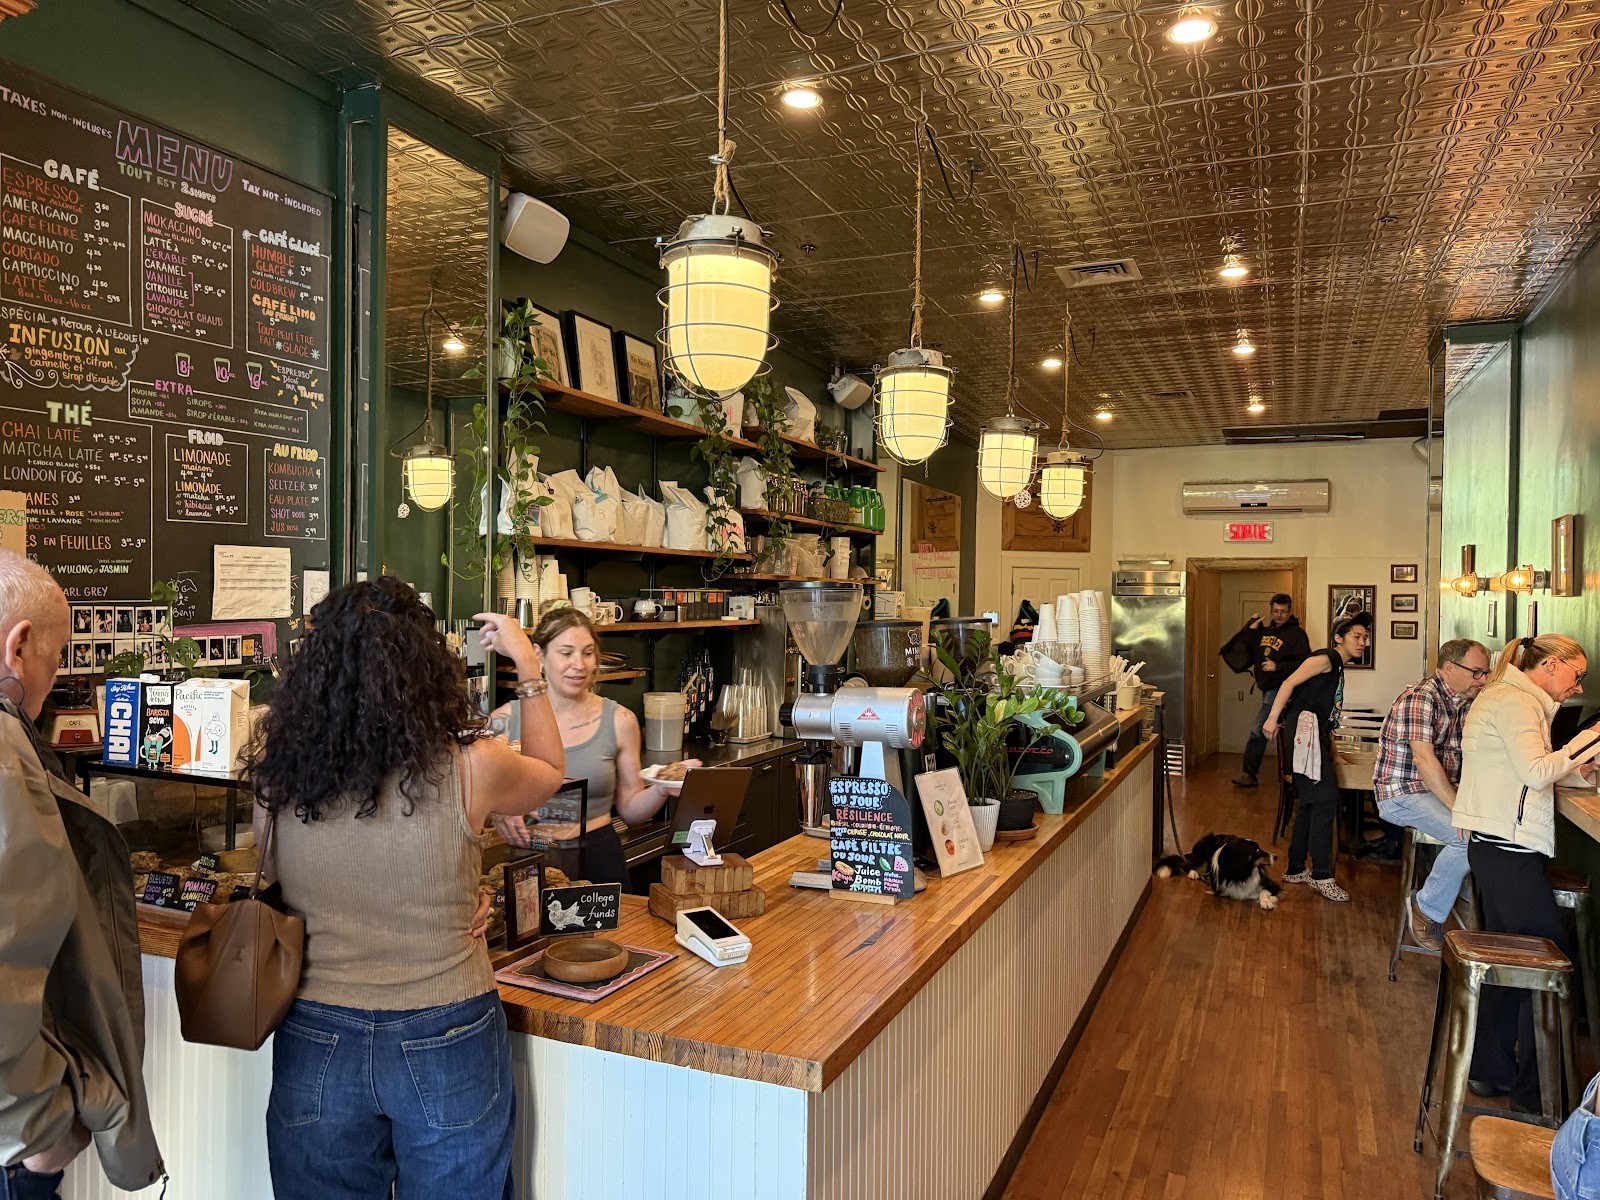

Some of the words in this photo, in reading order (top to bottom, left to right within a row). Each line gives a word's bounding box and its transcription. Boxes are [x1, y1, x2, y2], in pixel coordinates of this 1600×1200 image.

[0, 85, 47, 117] TAXES
[115, 120, 233, 192] MENU
[43, 159, 100, 191] CAFÉ
[118, 161, 152, 183] TOUT
[157, 176, 176, 190] EST
[3, 167, 79, 204] ESPRESSO
[3, 194, 79, 225] AMERICANO
[174, 202, 214, 227] SUCRÉ
[3, 210, 36, 229] CAFÉ
[40, 220, 79, 240] FILTRE
[144, 211, 202, 239] MOKACCINO
[3, 226, 73, 254] MACCHIATO
[259, 229, 287, 248] CAFÉ
[289, 237, 320, 257] GLACÉ
[2, 242, 60, 267] CORTADO
[251, 243, 295, 268] HUMBLE
[3, 257, 80, 287] CAPPUCCINO
[144, 259, 186, 276] CARAMEL
[146, 270, 183, 288] VANILLE
[145, 281, 189, 299] CITROUILLE
[147, 292, 184, 308] LAVANDE
[252, 293, 287, 313] CAFÉ
[290, 304, 316, 321] LIMO
[146, 302, 194, 320] CHOCOLAT
[197, 312, 223, 326] CHAUD
[256, 321, 275, 336] TOUT
[277, 329, 293, 341] PEUT
[9, 323, 110, 356] INFUSION
[114, 346, 127, 355] au
[260, 336, 276, 346] FAIT
[30, 359, 70, 371] cannelle
[74, 363, 84, 372] et
[180, 360, 187, 373] 8
[217, 365, 228, 380] 10
[277, 365, 310, 379] ESPRESSO
[62, 371, 84, 384] sirop
[131, 388, 158, 398] AVOINE
[154, 379, 194, 396] EXTRA
[131, 397, 151, 407] SOYA
[186, 397, 212, 408] SIROPS
[46, 400, 92, 426] THÉ
[131, 407, 164, 417] AMANDE
[186, 409, 207, 419] SIROP
[2, 421, 40, 439] CHAI
[187, 429, 224, 446] FROID
[2, 440, 62, 459] MATCHA
[273, 443, 289, 457] AU
[291, 446, 318, 462] FRIGO
[173, 448, 232, 467] LIMONADE
[3, 465, 56, 482] LONDON
[61, 470, 83, 484] FOG
[182, 463, 214, 473] maison
[268, 462, 314, 477] KOMBUCHA
[175, 480, 222, 494] LIMONADE
[269, 479, 306, 491] SELTZER
[26, 492, 59, 506] ANES
[183, 493, 210, 501] matcha
[269, 494, 284, 505] EAU
[287, 495, 309, 506] PLATE
[184, 500, 214, 510] hibiscus
[271, 507, 290, 519] SHOT
[47, 517, 82, 525] LAVANDE
[271, 521, 285, 532] JUS
[1229, 523, 1269, 540] SORTIE
[43, 537, 56, 546] EN
[60, 534, 112, 551] FEUILLES
[99, 564, 129, 574] JASMIN
[64, 587, 81, 597] ARL
[84, 585, 108, 597] GREY
[173, 607, 195, 620] Benji
[175, 688, 202, 700] Pacific
[146, 708, 169, 717] BARISTA
[108, 702, 133, 761] CHAI
[830, 780, 889, 796] ESPRESSO
[833, 795, 848, 805] DU
[850, 796, 880, 808] JOUR
[836, 808, 893, 822] RÉSILIENCE
[894, 832, 910, 841] NOIR
[831, 839, 859, 852] CAFÉ
[861, 840, 902, 855] FILTRE
[833, 851, 847, 859] DU
[848, 852, 876, 865] JOUR
[854, 865, 881, 877] Juice
[149, 873, 173, 885] BLEUETS
[854, 875, 882, 886] Bomb
[184, 880, 215, 895] POMMES
[580, 894, 615, 907] college
[587, 906, 616, 922] funds
